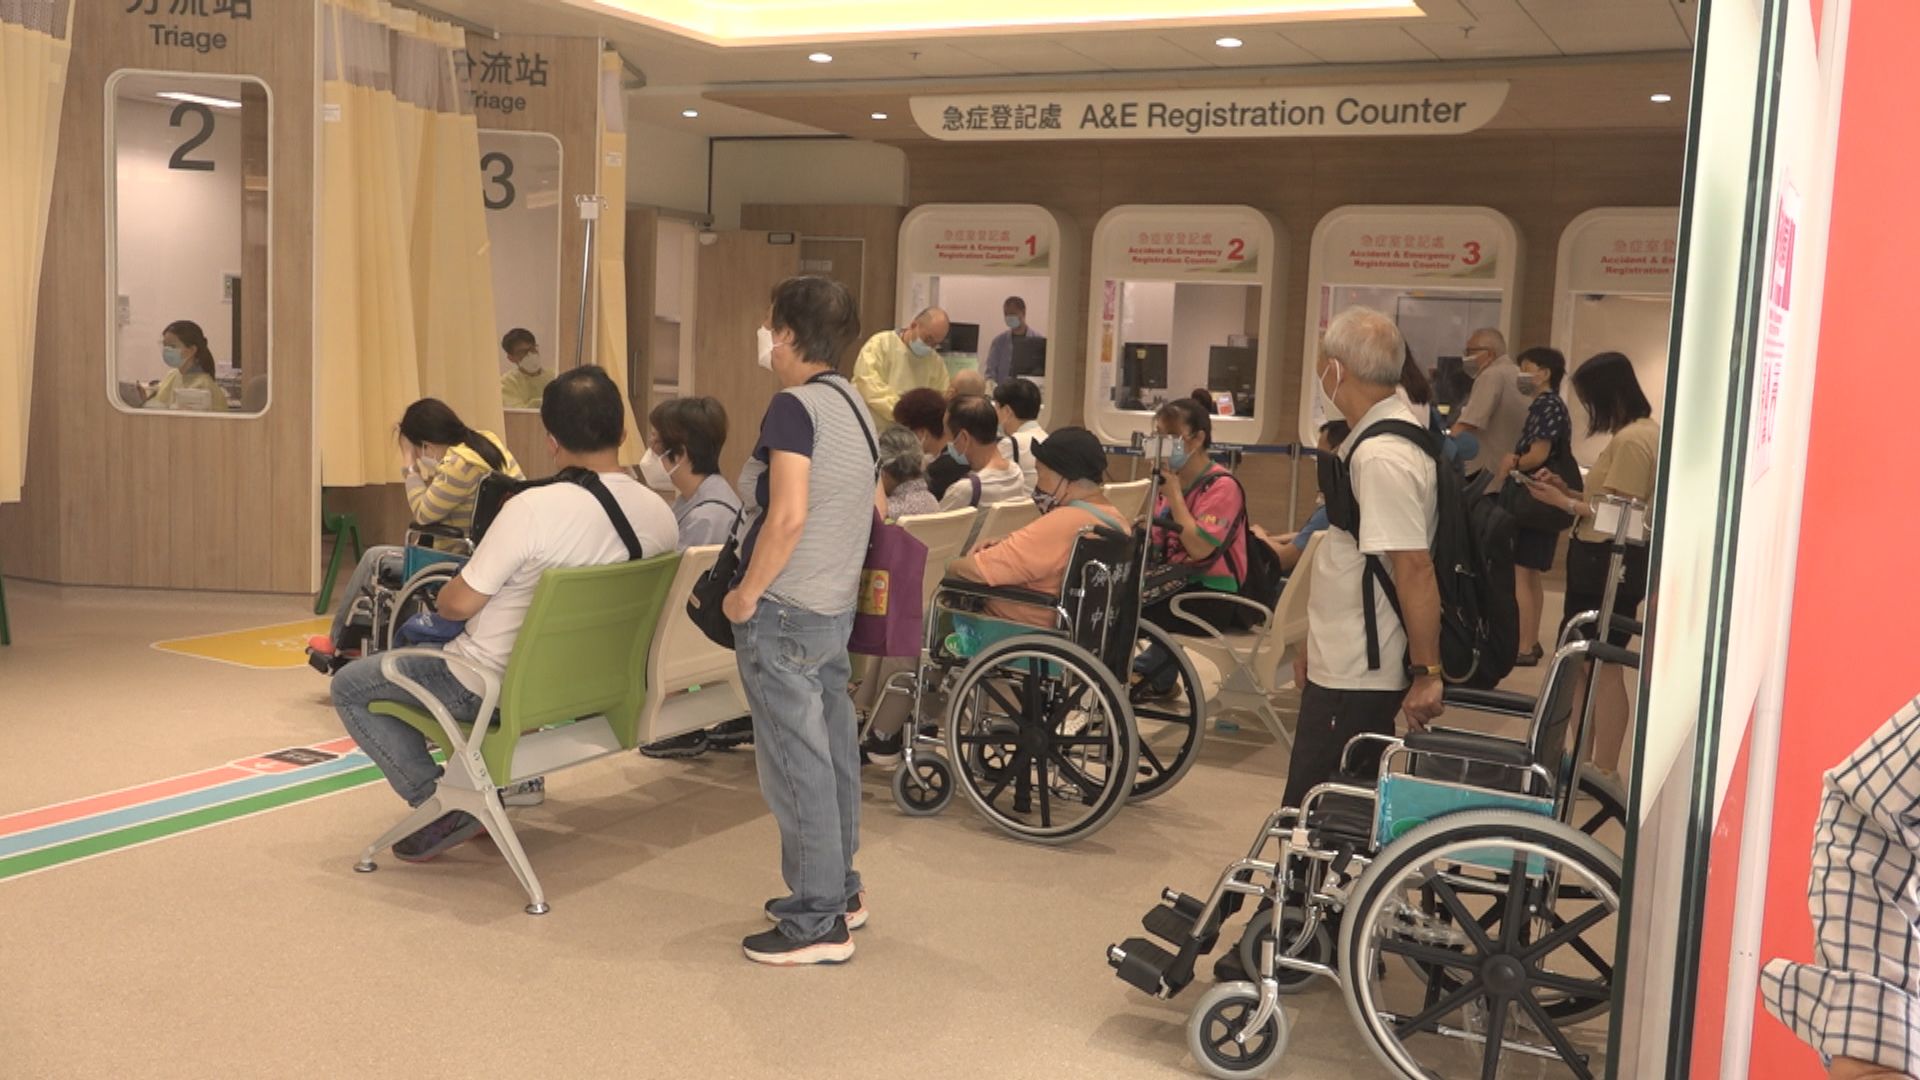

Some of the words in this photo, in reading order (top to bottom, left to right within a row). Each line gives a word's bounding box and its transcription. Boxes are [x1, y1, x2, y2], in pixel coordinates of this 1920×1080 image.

[149, 24, 228, 54] Triage
[942, 104, 1062, 130] 急症登記處
[1080, 103, 1138, 129] A&E
[1147, 100, 1325, 133] Registration
[1335, 97, 1467, 126] Counter
[168, 103, 216, 172] 2
[480, 152, 516, 210] 3
[978, 243, 1020, 253] Emergency
[1024, 234, 1037, 257] 1
[1128, 246, 1165, 254] Accident
[1176, 247, 1223, 257] Emergency
[1227, 238, 1245, 261] 2
[1461, 241, 1481, 266] 3
[938, 251, 984, 260] Registration
[985, 252, 1016, 260] Counter
[1132, 256, 1182, 265] Registration
[1184, 256, 1217, 265] Counter
[1349, 249, 1391, 258] Accident
[1403, 249, 1456, 261] Emergency
[1601, 255, 1647, 264] Accident
[1353, 259, 1410, 269] Registration
[1412, 260, 1450, 270] Counter
[1605, 266, 1670, 276] Registration
